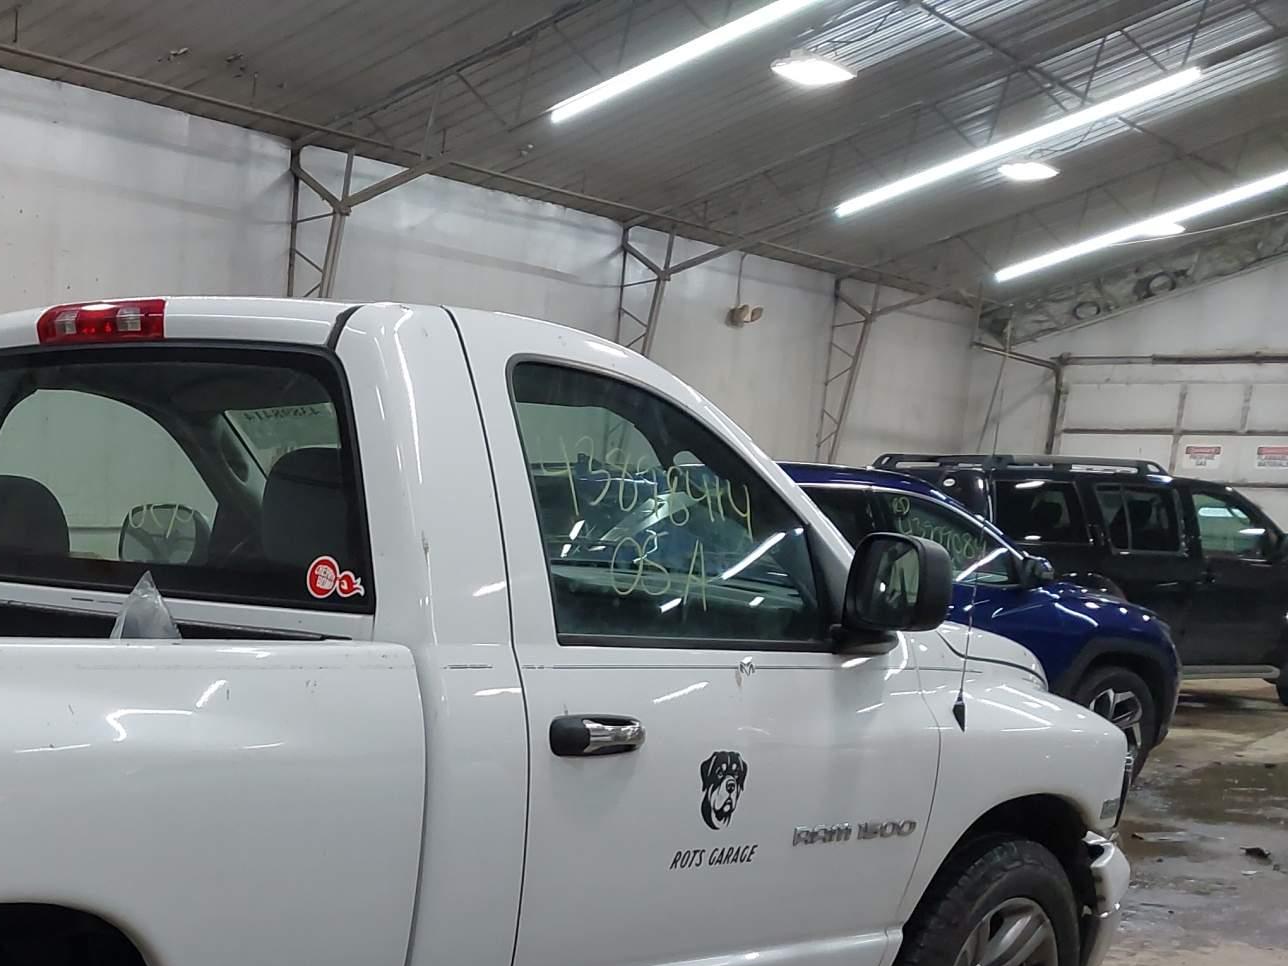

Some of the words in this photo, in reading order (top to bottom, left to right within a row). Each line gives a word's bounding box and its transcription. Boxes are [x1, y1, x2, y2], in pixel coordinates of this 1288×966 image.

[792, 822, 853, 846] RAM
[857, 819, 917, 840] 1500
[669, 848, 706, 870] ROTS
[707, 843, 759, 867] GARAGE
